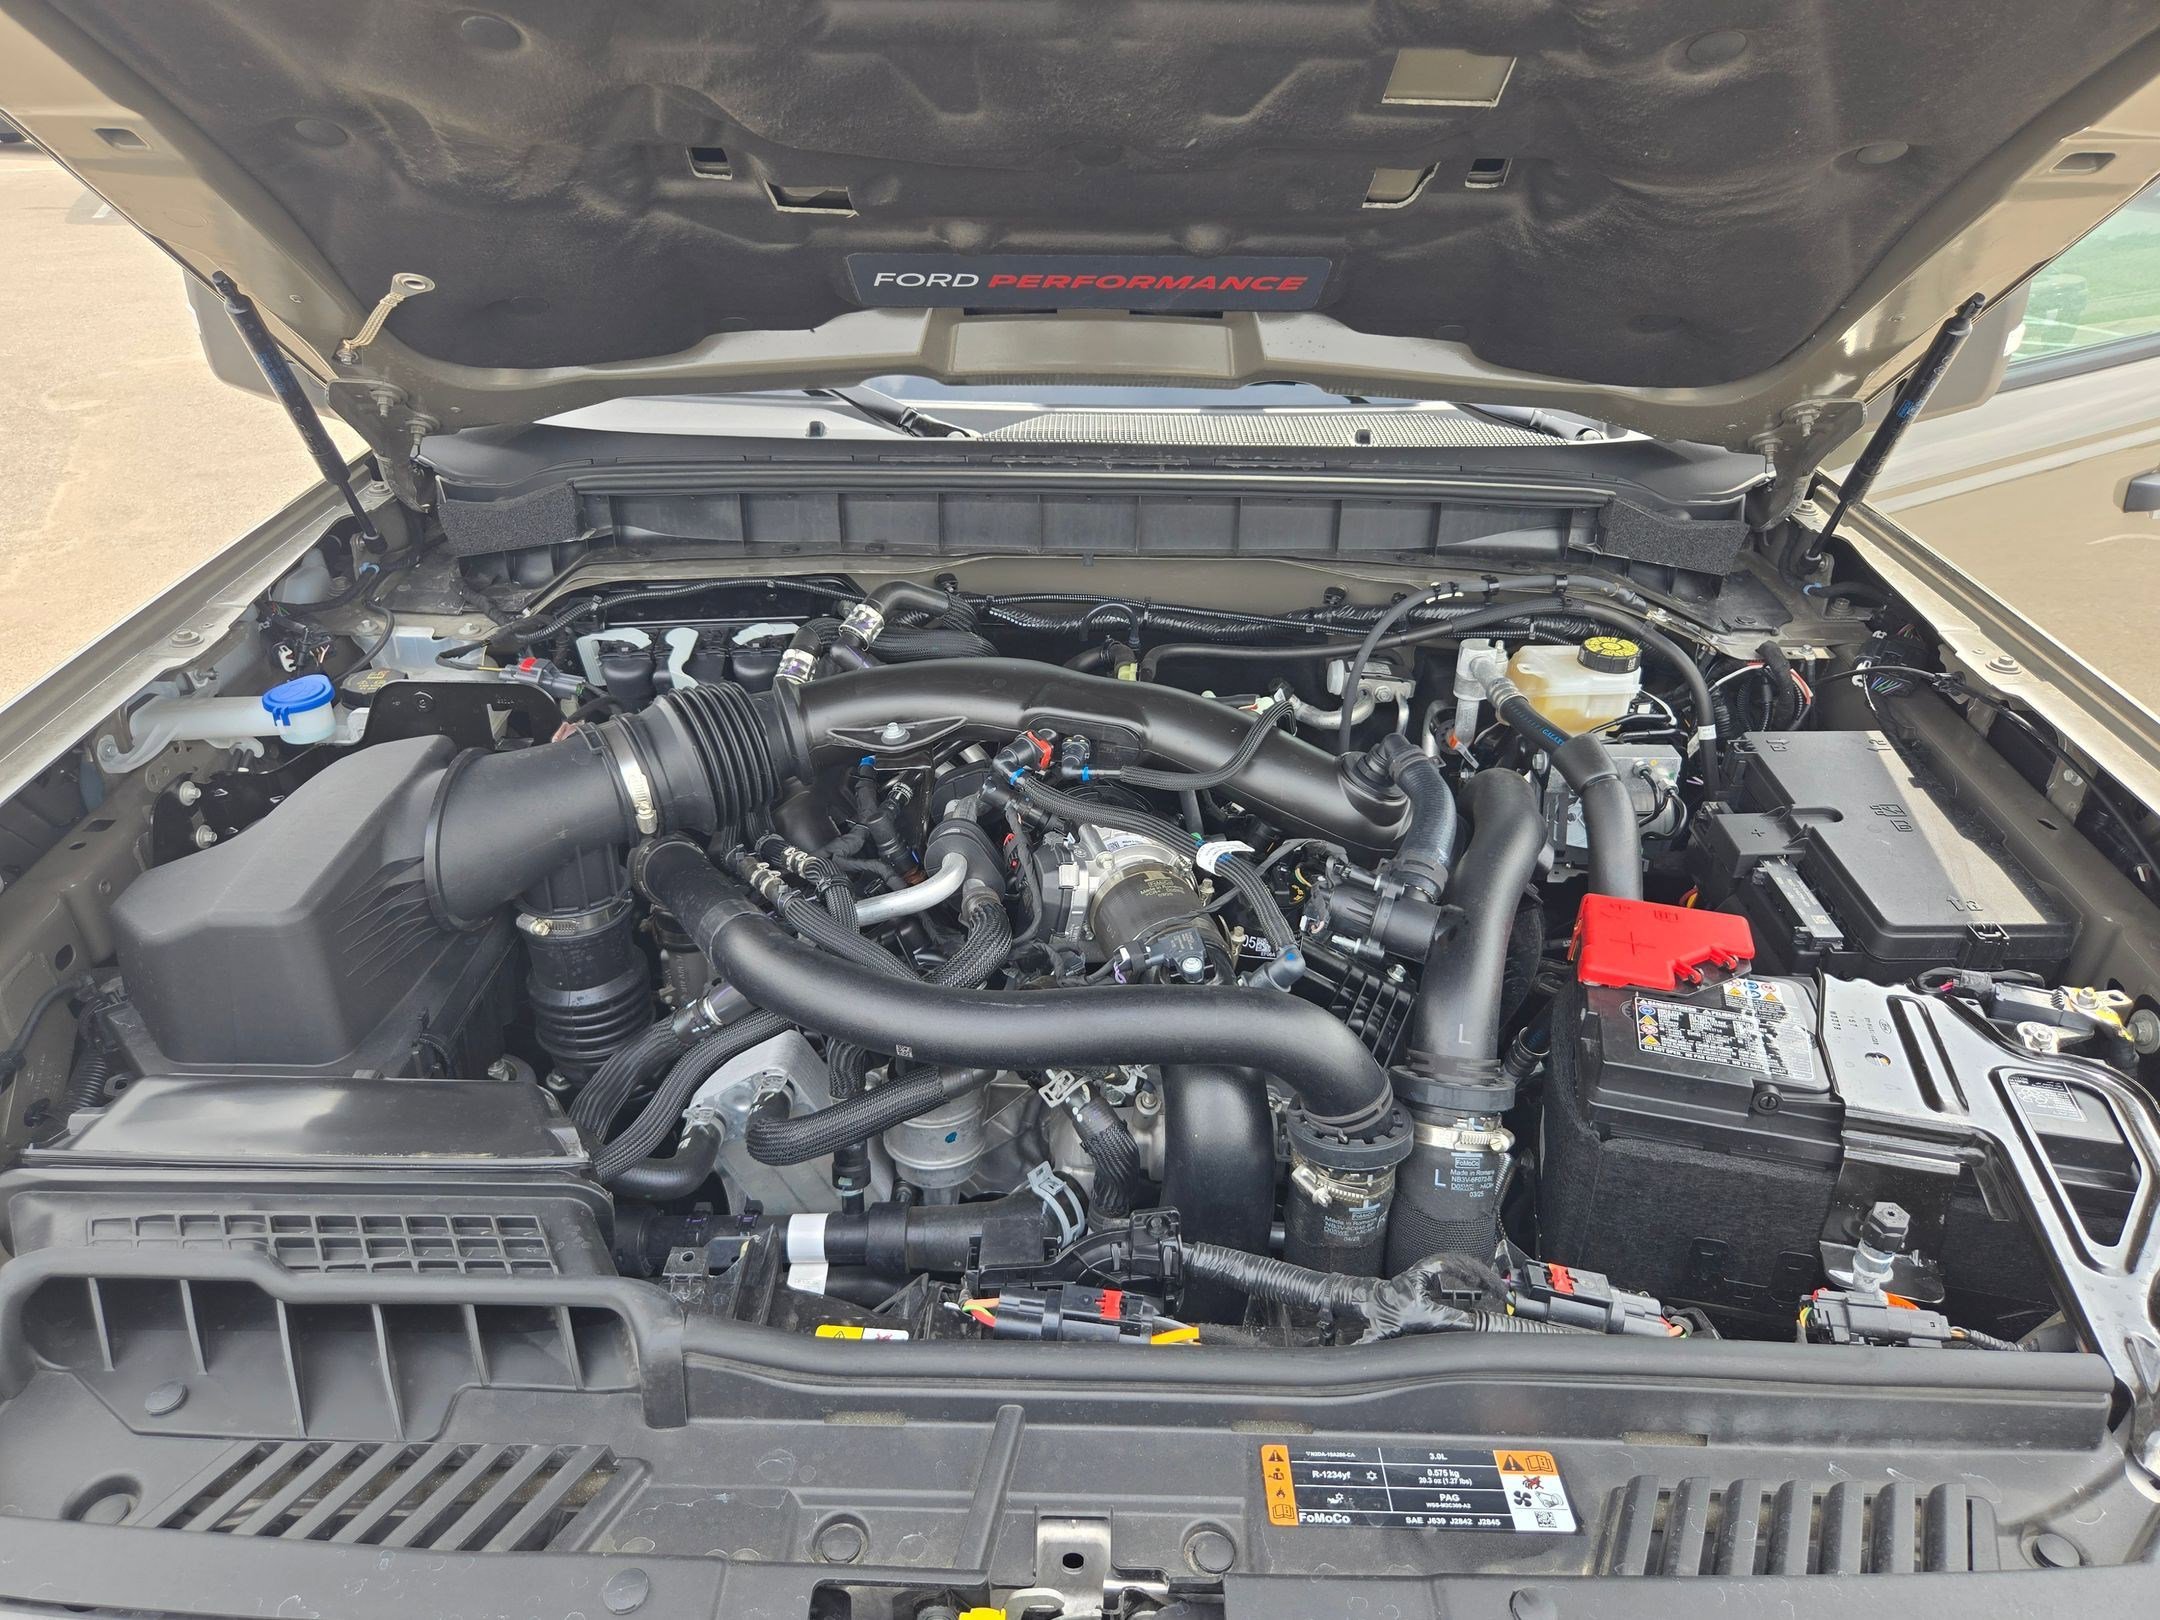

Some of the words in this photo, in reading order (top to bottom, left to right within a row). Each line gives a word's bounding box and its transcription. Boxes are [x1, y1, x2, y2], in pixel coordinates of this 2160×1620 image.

[874, 273, 980, 288] FORD
[988, 274, 1309, 292] PERFORMANCE
[1459, 1023, 1472, 1045] L
[1434, 1168, 1447, 1187] L
[1429, 1452, 1448, 1460] 3.0L
[1312, 1470, 1351, 1480] R-1234yf
[1427, 1468, 1448, 1477] 0.575
[1448, 1469, 1460, 1478] kg
[1459, 1478, 1472, 1487] lbs)
[1439, 1493, 1460, 1502] PAG
[1299, 1512, 1350, 1524] FoMoCo
[1405, 1516, 1424, 1524] SAE
[1450, 1518, 1473, 1526] J2842
[1478, 1518, 1501, 1526] J2845
